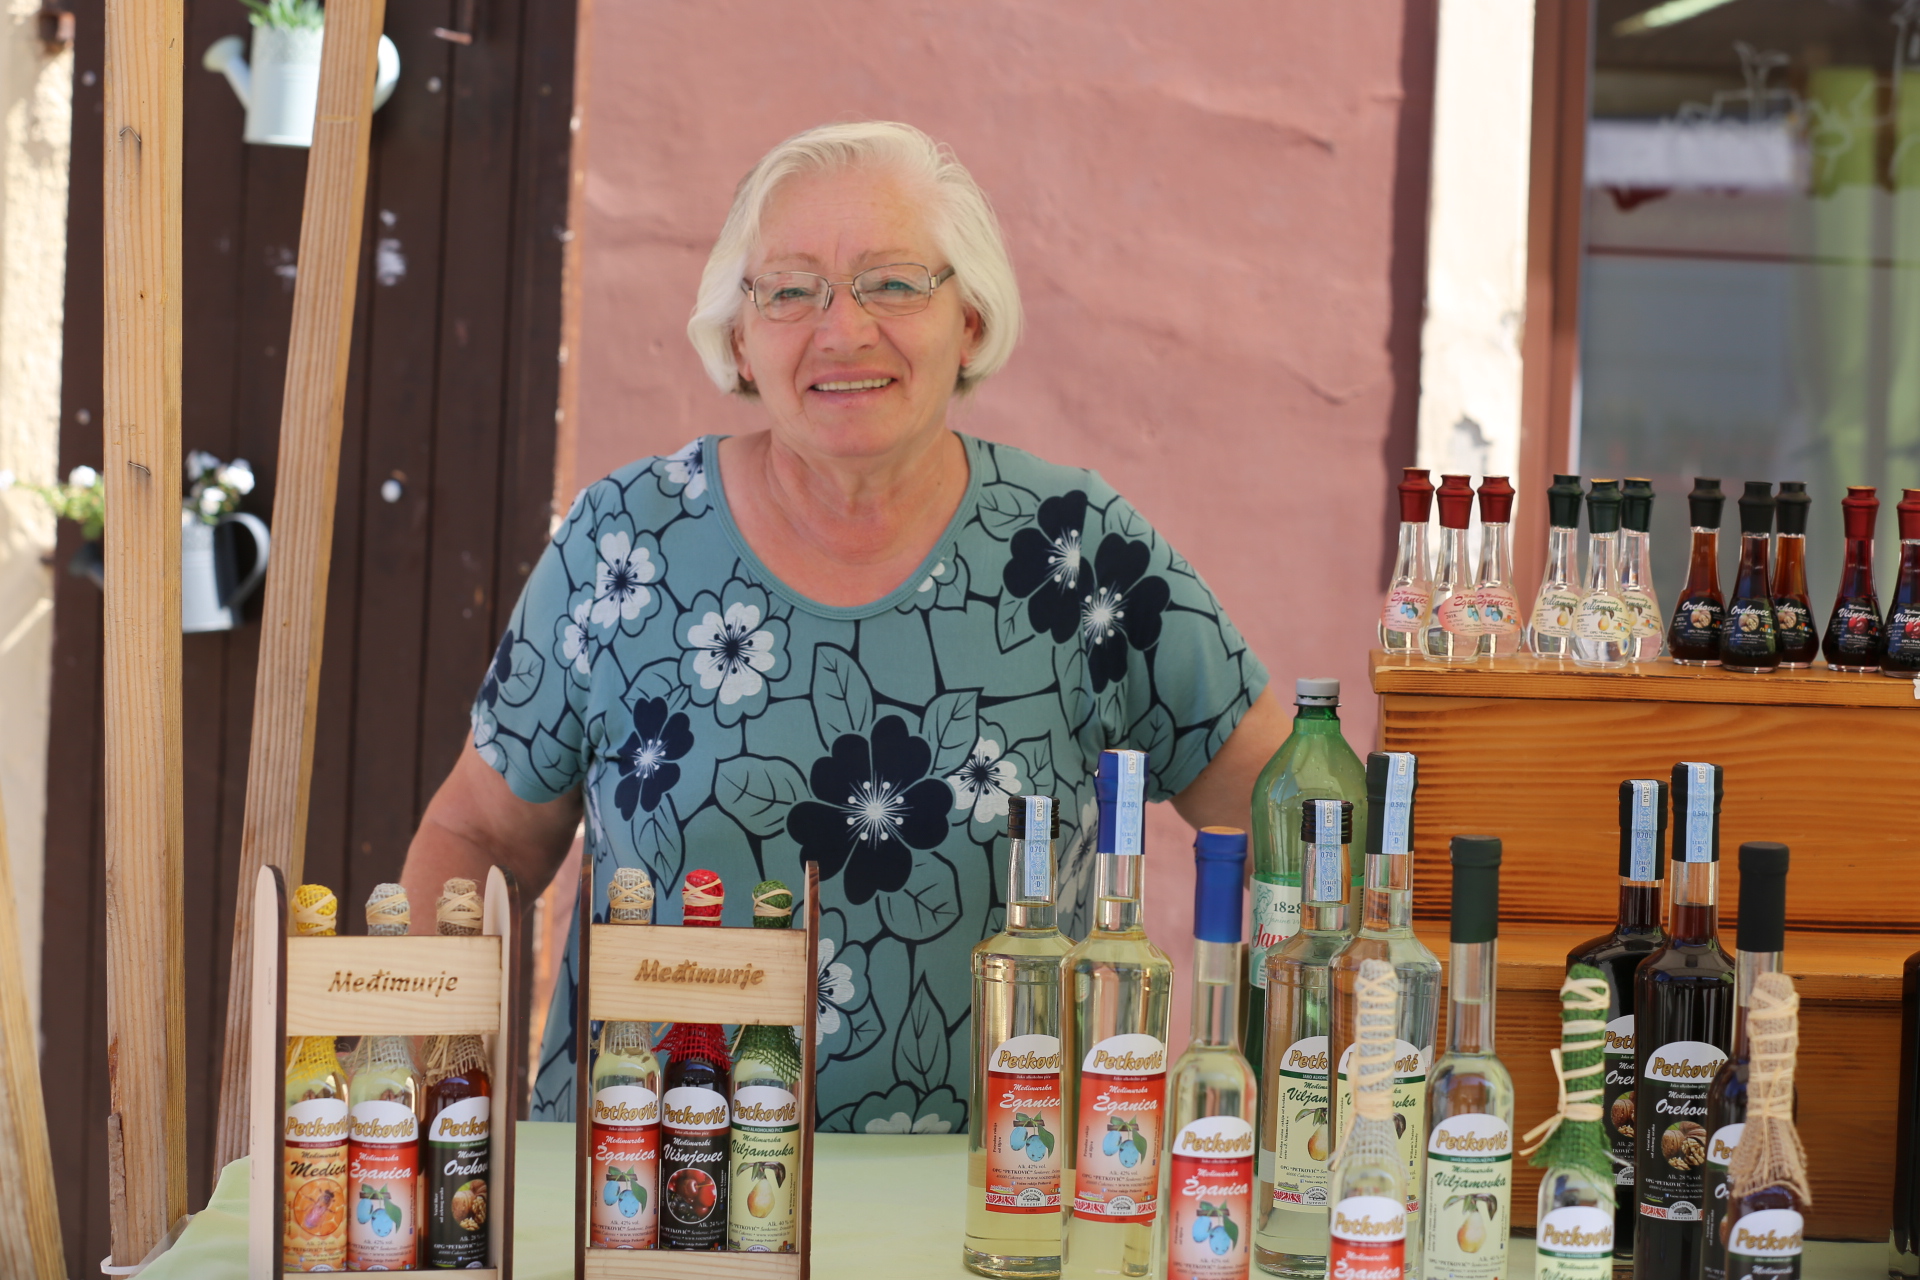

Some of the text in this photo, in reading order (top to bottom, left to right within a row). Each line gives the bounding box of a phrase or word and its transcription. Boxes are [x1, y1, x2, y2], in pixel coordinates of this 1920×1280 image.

[1730, 605, 1770, 617] Orehovec
[327, 968, 458, 998] Međimurje
[634, 958, 765, 990] Međimurje
[998, 1049, 1060, 1070] Petkovi
[1093, 1049, 1163, 1071] Petković
[1288, 1049, 1328, 1070] Petk
[1092, 1092, 1158, 1116] Žganica
[1286, 1087, 1328, 1106] Viljam
[1655, 1098, 1708, 1116] Orehov
[595, 1099, 658, 1121] Petković
[663, 1102, 727, 1126] Petković
[732, 1098, 796, 1122] Petković
[731, 1139, 795, 1160] Viljamovka
[1181, 1131, 1252, 1153] Petković
[1435, 1129, 1508, 1151] Petković
[595, 1141, 656, 1166] Žganica
[663, 1143, 723, 1168] Višnjevec
[349, 1159, 413, 1183] Žganica
[1434, 1171, 1507, 1193] Viljamovka
[1181, 1174, 1249, 1201] Žganica
[1334, 1211, 1405, 1236] Petković
